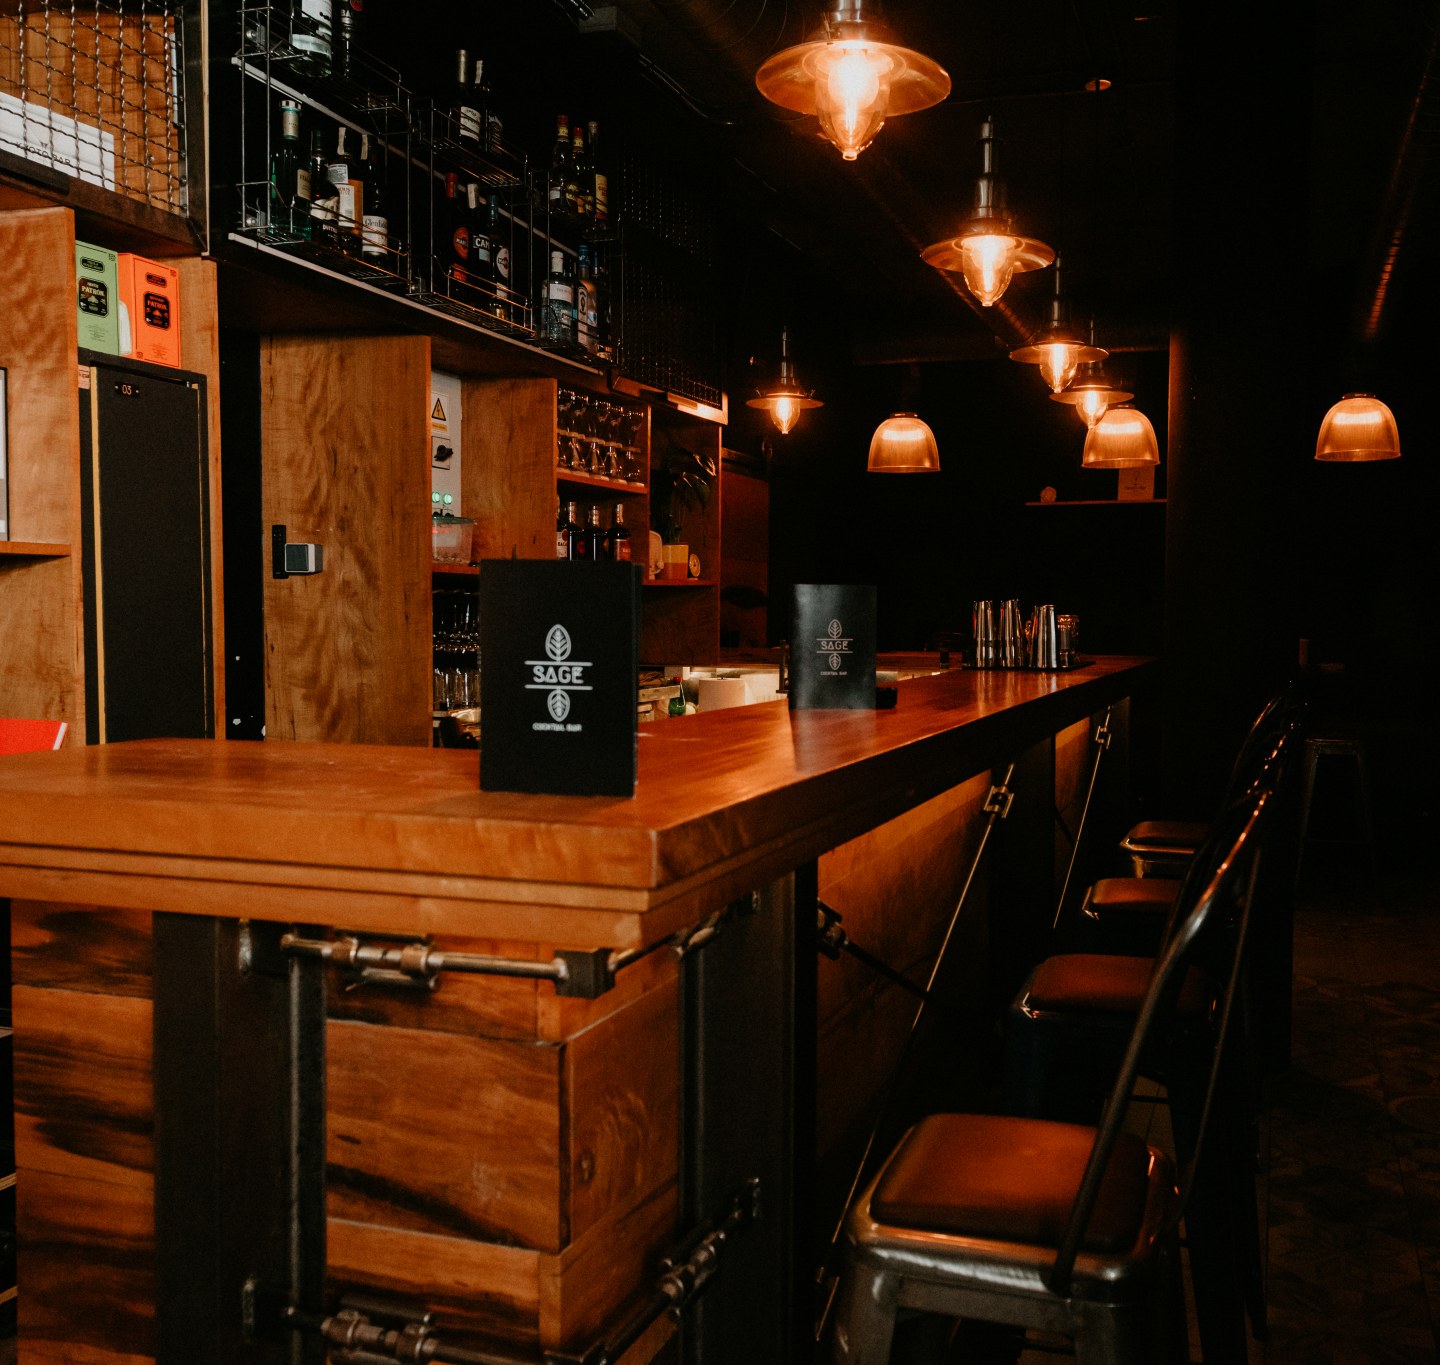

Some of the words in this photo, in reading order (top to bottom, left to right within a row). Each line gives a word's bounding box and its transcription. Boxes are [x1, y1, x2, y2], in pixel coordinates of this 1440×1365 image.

[121, 384, 132, 396] 03
[820, 640, 849, 651] SAGE
[532, 665, 584, 684] SAGE
